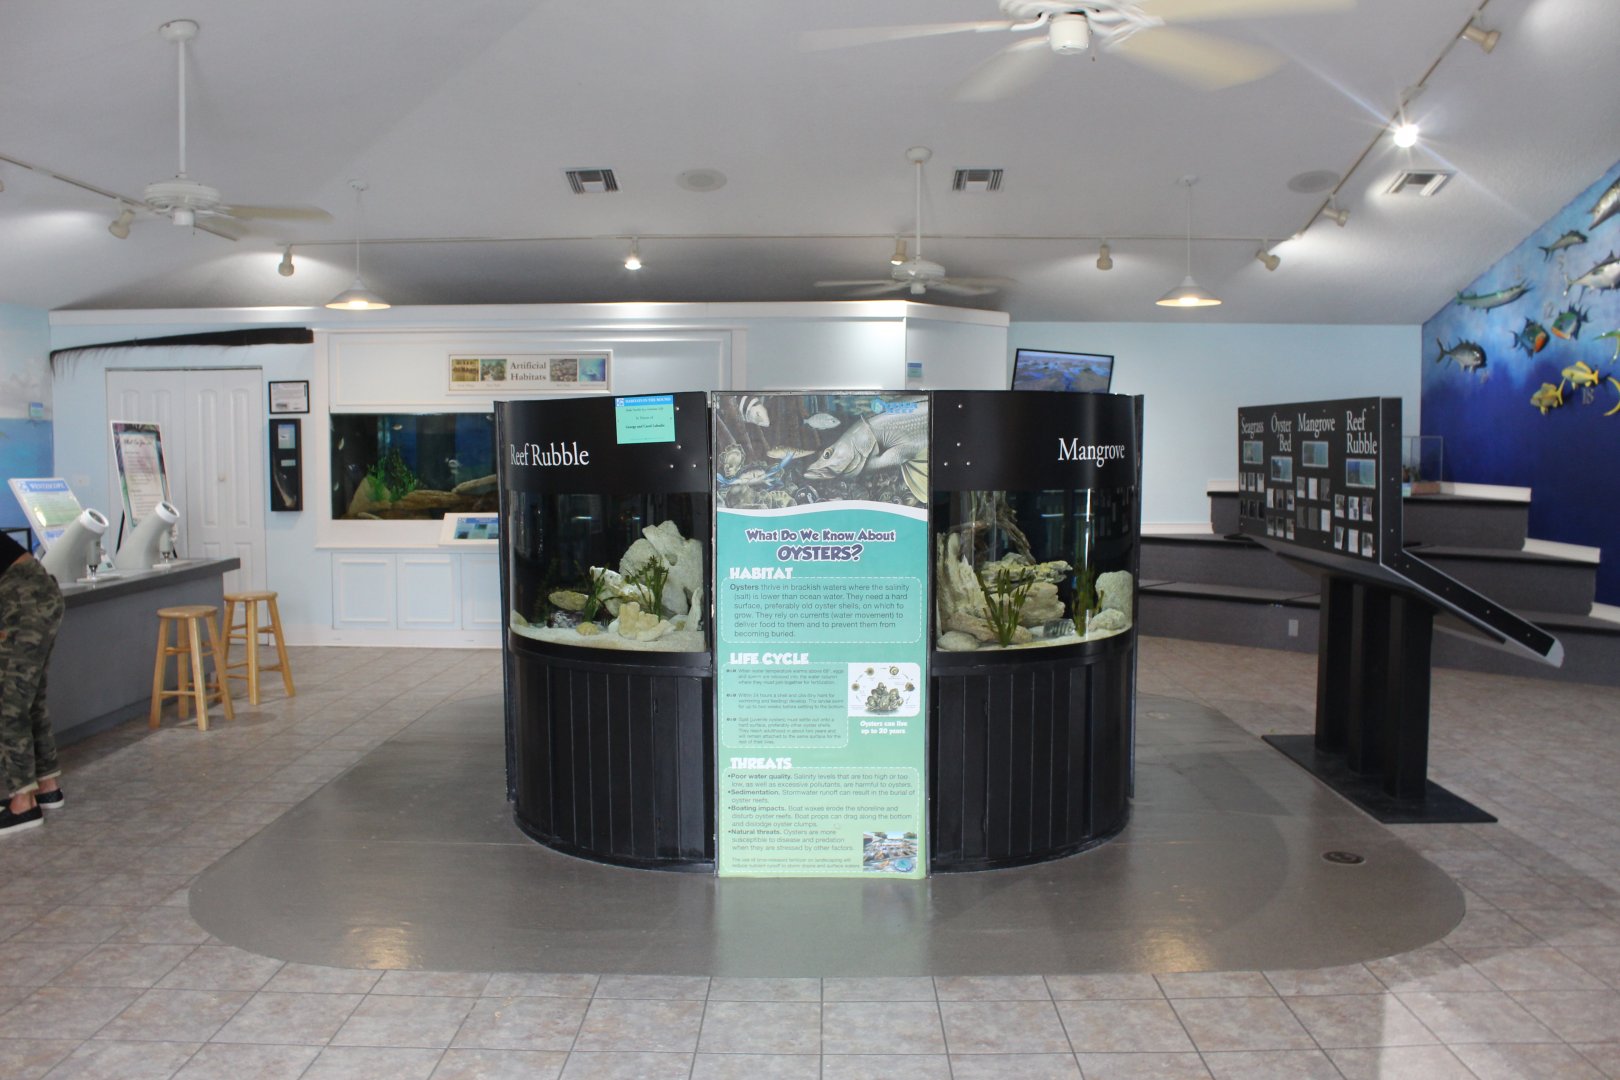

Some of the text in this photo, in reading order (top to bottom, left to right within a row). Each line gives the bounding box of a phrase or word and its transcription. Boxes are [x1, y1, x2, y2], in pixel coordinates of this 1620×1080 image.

[510, 361, 547, 370] Artificial
[510, 373, 547, 381] Habitats
[1298, 412, 1336, 438] Mangrove
[1346, 408, 1367, 431] Reef
[1241, 417, 1264, 439] Seagrass
[1271, 415, 1292, 439] Oyster
[1279, 434, 1292, 452] Bed
[1347, 432, 1378, 455] Rubble
[510, 441, 590, 467] Reef Rubble
[1058, 437, 1125, 468] Mangrove
[745, 528, 896, 543] What Do We Know About
[777, 543, 863, 562] OYSTERS?
[730, 567, 793, 580] HABITAT
[730, 584, 759, 592] Oysters
[885, 584, 909, 592] salinity
[734, 593, 751, 601] (salt)
[846, 593, 864, 601] They
[764, 602, 800, 610] preferably
[814, 602, 837, 610] oyster
[755, 612, 773, 620] They
[775, 612, 787, 620] rely
[831, 612, 853, 620] (water
[855, 612, 894, 620] movement)
[730, 652, 809, 665] LIFE CYCLE
[860, 720, 883, 728] Oysters
[730, 757, 792, 769] THREATS
